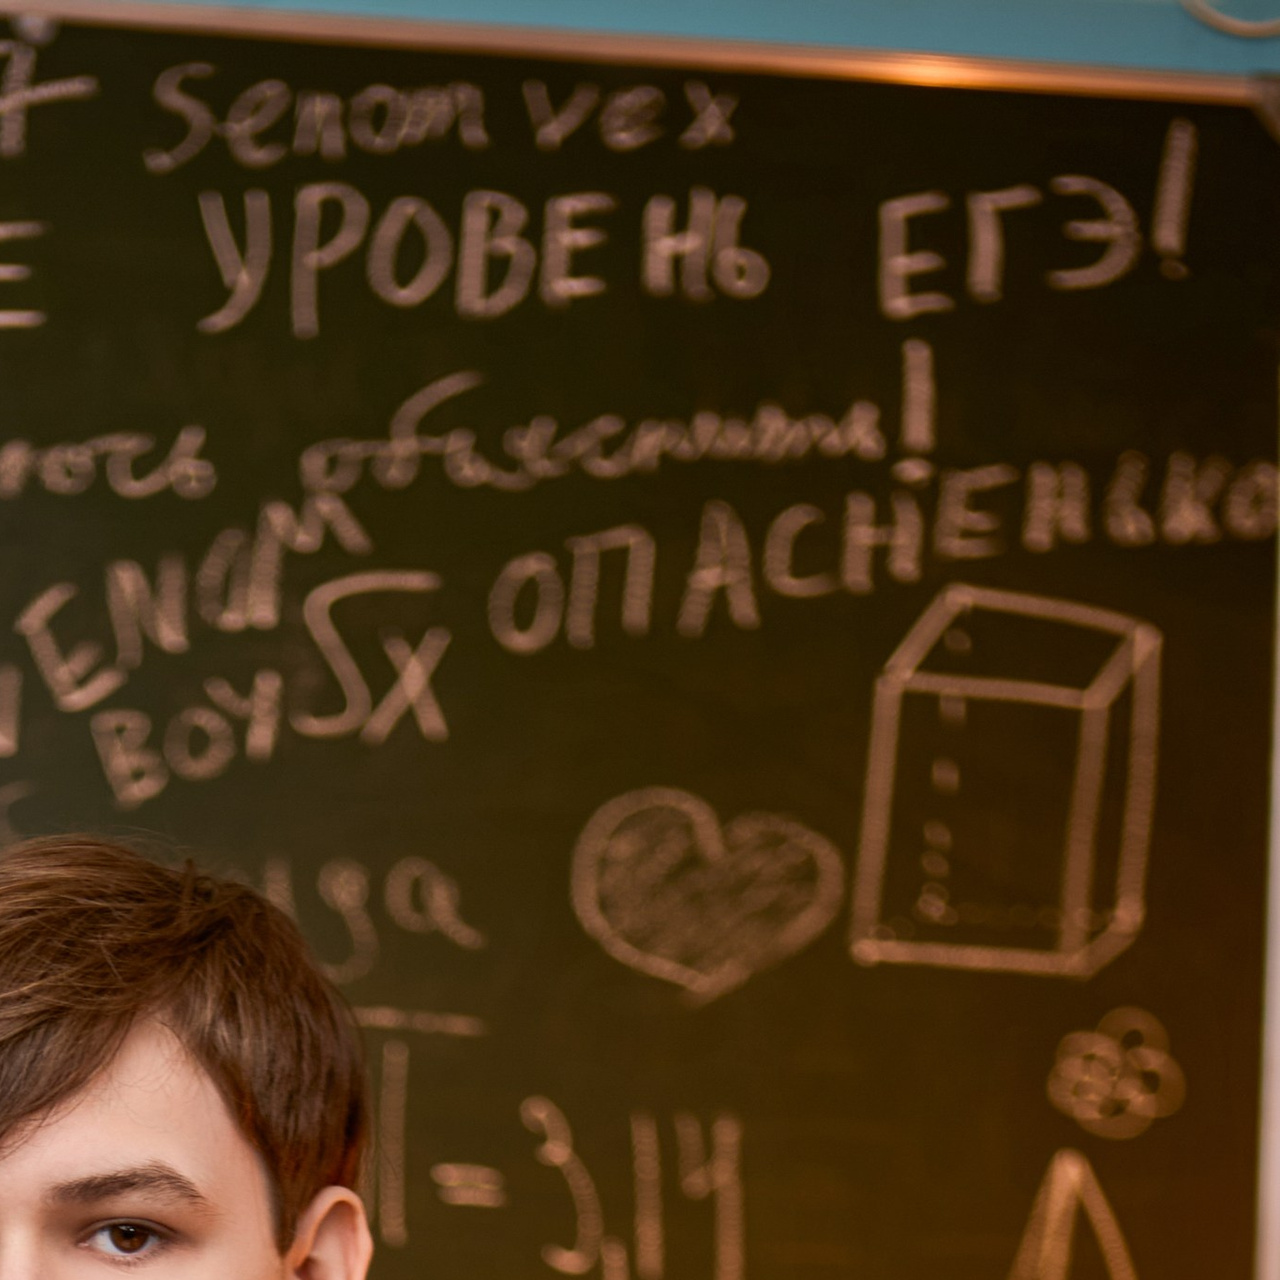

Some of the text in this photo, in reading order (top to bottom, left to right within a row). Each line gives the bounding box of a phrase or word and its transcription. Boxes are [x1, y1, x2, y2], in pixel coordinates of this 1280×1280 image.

[196, 182, 770, 338] УРОВЕНЬ
[878, 118, 1198, 320] ЕГЭ!
[488, 450, 1278, 655] ОПАСНЕНЬКО
